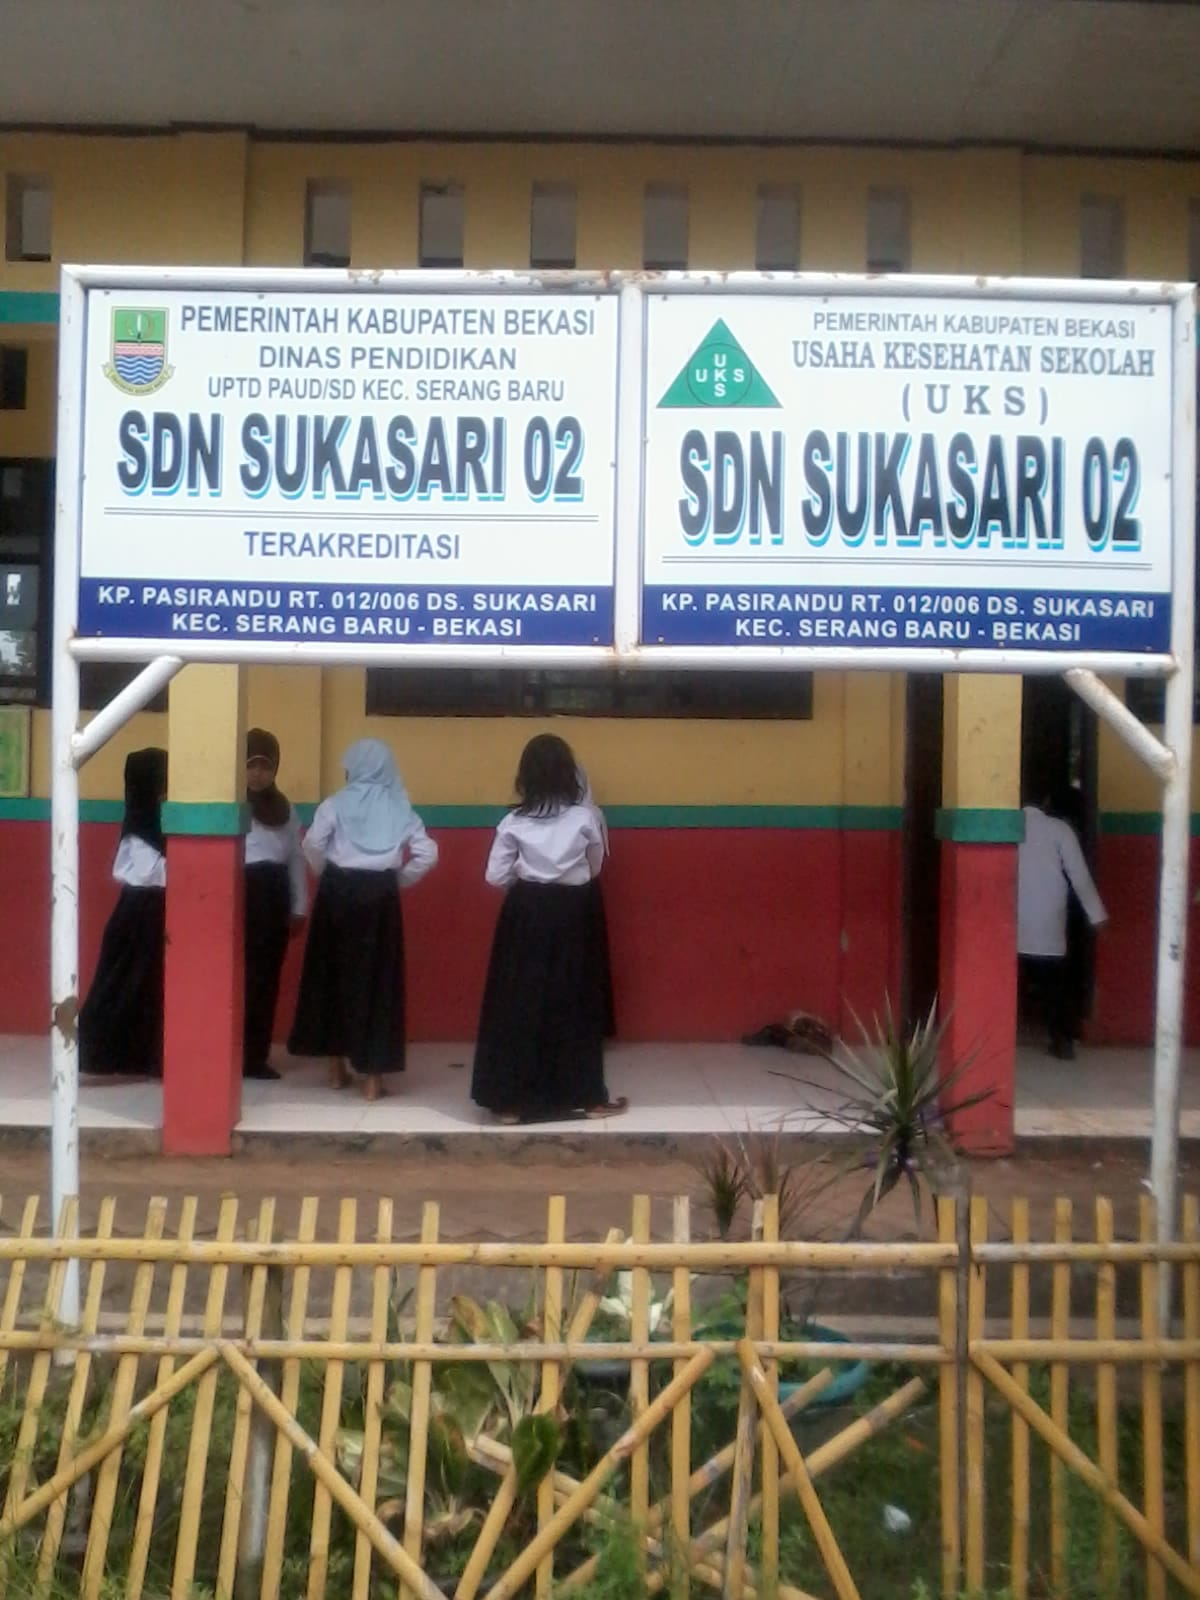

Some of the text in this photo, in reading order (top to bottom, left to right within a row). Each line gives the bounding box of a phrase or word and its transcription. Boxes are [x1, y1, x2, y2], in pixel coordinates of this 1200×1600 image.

[181, 305, 595, 336] PEMERINTAH KABUPATEN BEKASI
[813, 312, 1135, 338] PEMERINTAH KABUPATEN BEKASI
[259, 346, 516, 370] DINAS PENDIDIKAN
[793, 340, 1155, 377] USAHA KESEHATAN SEKOLAH
[209, 377, 564, 401] UPTD PAUD/SD KEC. SERANG BARU
[116, 410, 584, 502] SDN SUKASARI 02
[678, 429, 1141, 551] SDN SUKASARI 02
[244, 531, 459, 560] TERAKREDITASI
[99, 586, 596, 612] KP. PASIRANDU RT. 012/006 DS. SUKASARI
[662, 593, 1154, 619] KP. PASIRANDU RT. 012/006 DS. SUKASARI
[172, 613, 228, 633] KEC.
[236, 614, 335, 634] SERANG
[344, 616, 411, 635] BARU
[433, 617, 521, 637] BEKASI
[736, 619, 791, 638] KEC.
[799, 619, 897, 639] SERANG
[905, 620, 972, 640] BARU
[993, 622, 1080, 642] BEKASI
